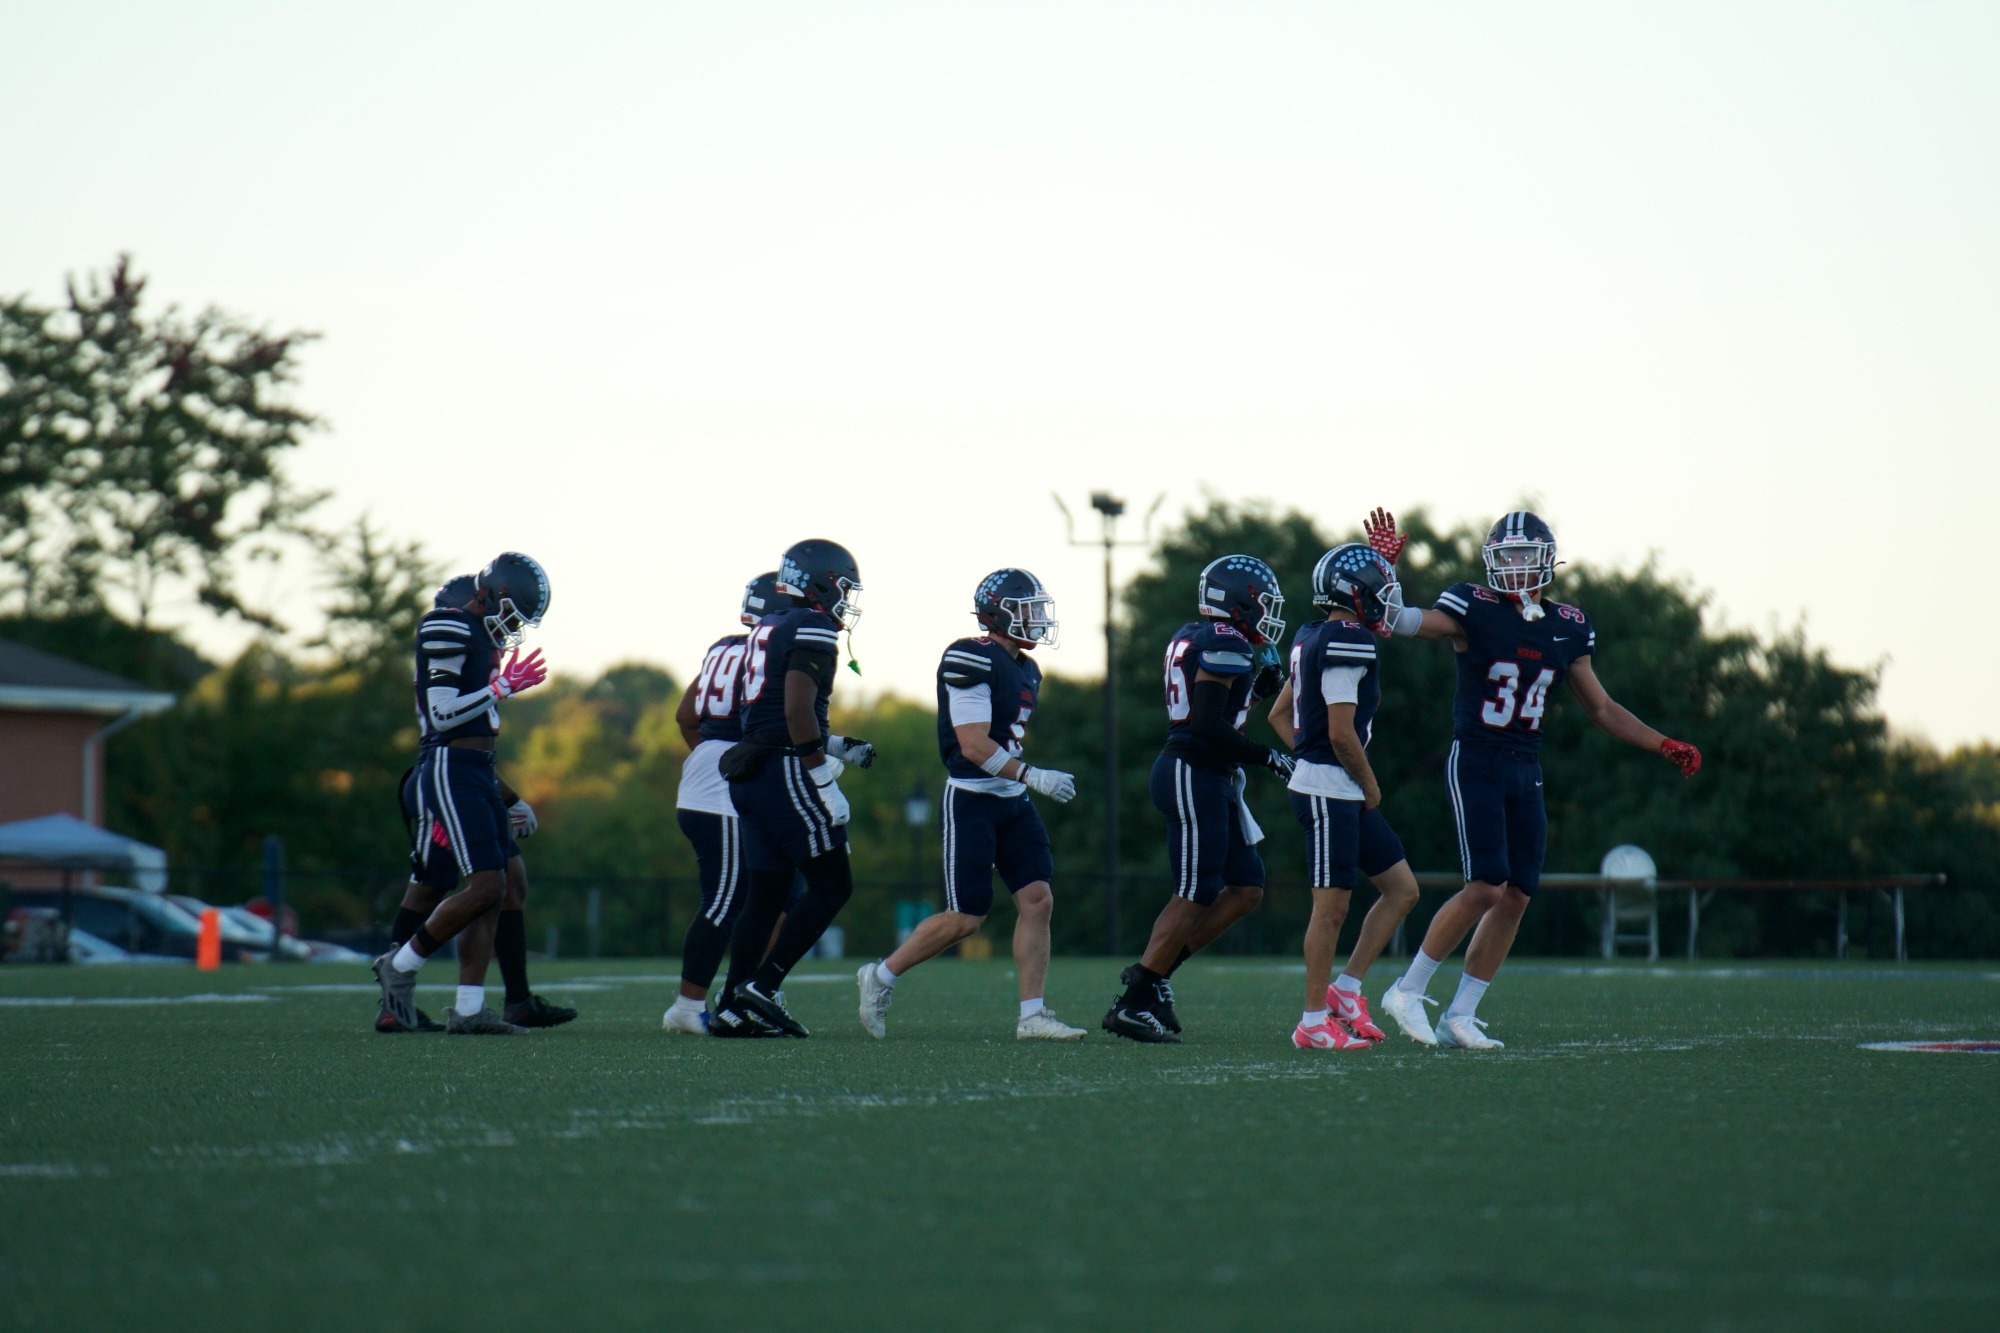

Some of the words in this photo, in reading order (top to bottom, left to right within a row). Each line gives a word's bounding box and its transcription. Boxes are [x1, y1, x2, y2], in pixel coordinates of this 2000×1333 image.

[695, 644, 746, 718] 99
[1480, 660, 1556, 732] 34
[718, 1008, 744, 1028] NIKE
